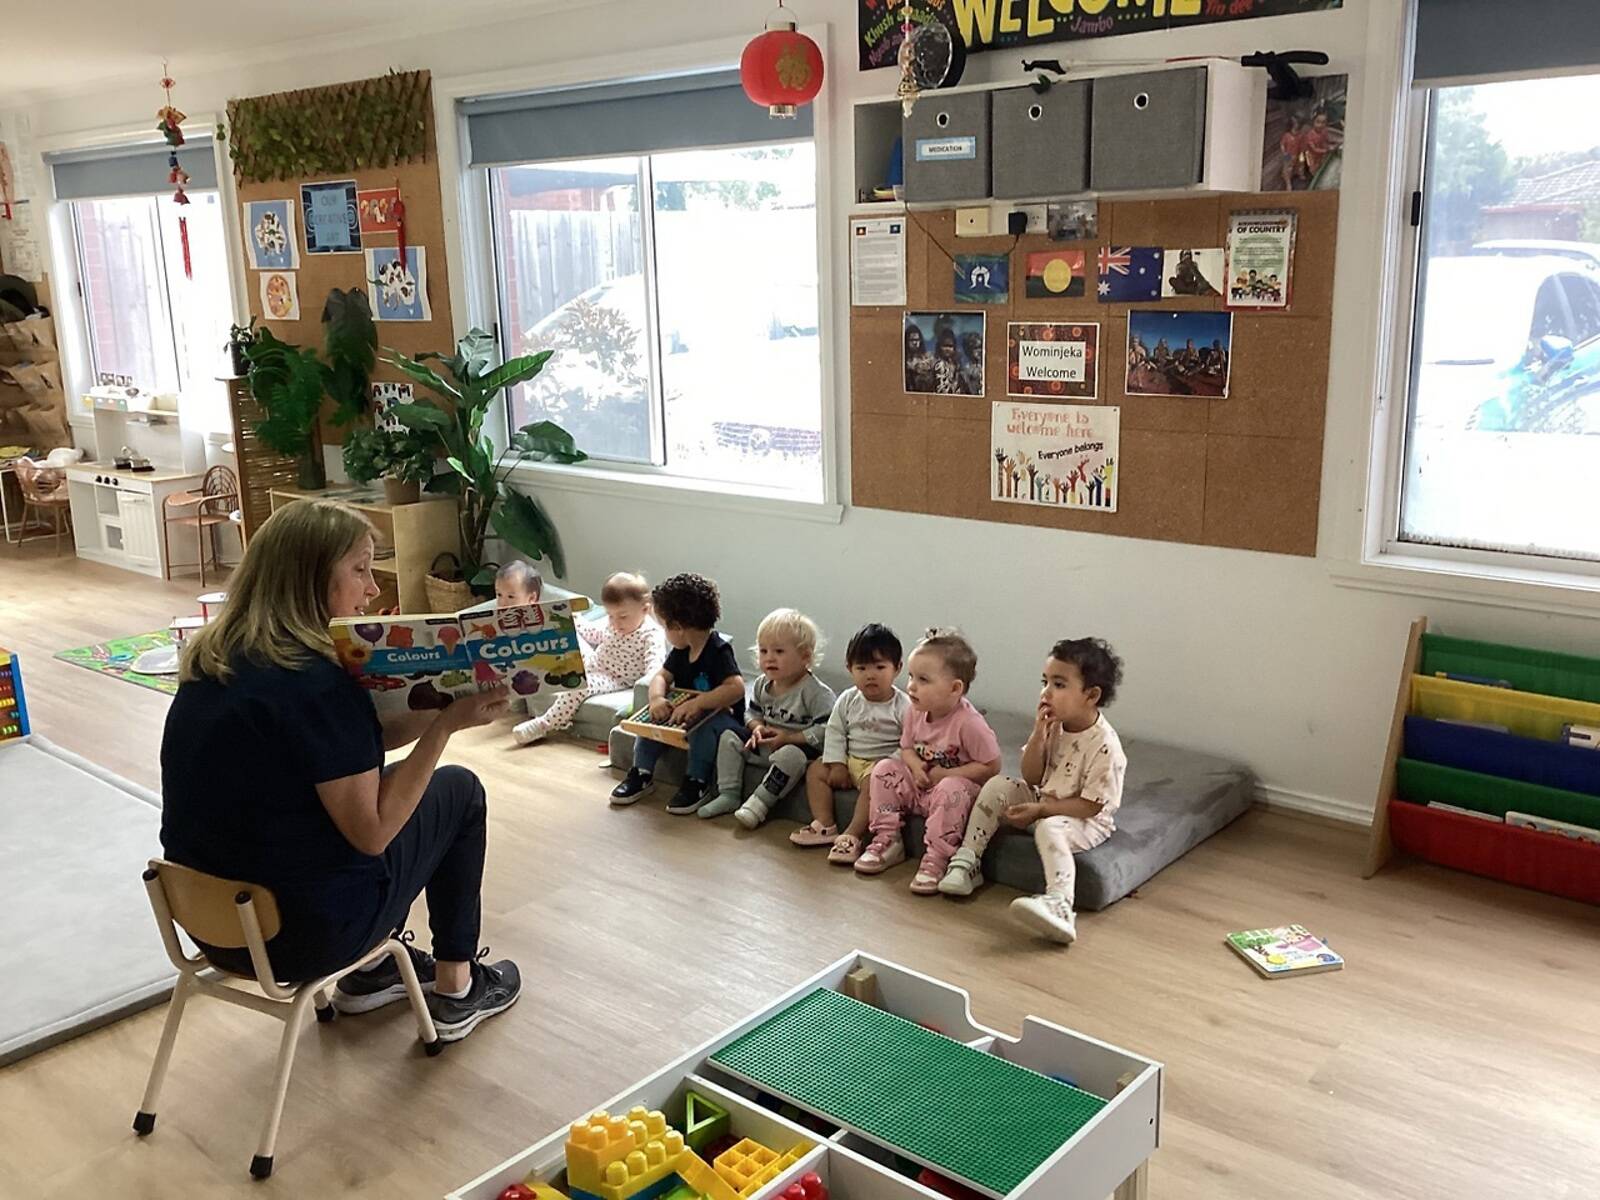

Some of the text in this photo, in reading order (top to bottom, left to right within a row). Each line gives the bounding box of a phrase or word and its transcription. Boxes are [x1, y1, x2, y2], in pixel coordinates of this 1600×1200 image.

[1070, 17, 1113, 34] Jambo
[1236, 225, 1286, 234] OF COUNTRY
[1022, 345, 1082, 360] Wominjeka
[1026, 366, 1077, 379] Welcome
[1011, 407, 1070, 426] Everyone
[1007, 421, 1093, 438] welcome here
[1038, 442, 1104, 460] Everyone belongs
[387, 650, 441, 663] Colours
[479, 636, 570, 660] Colours
